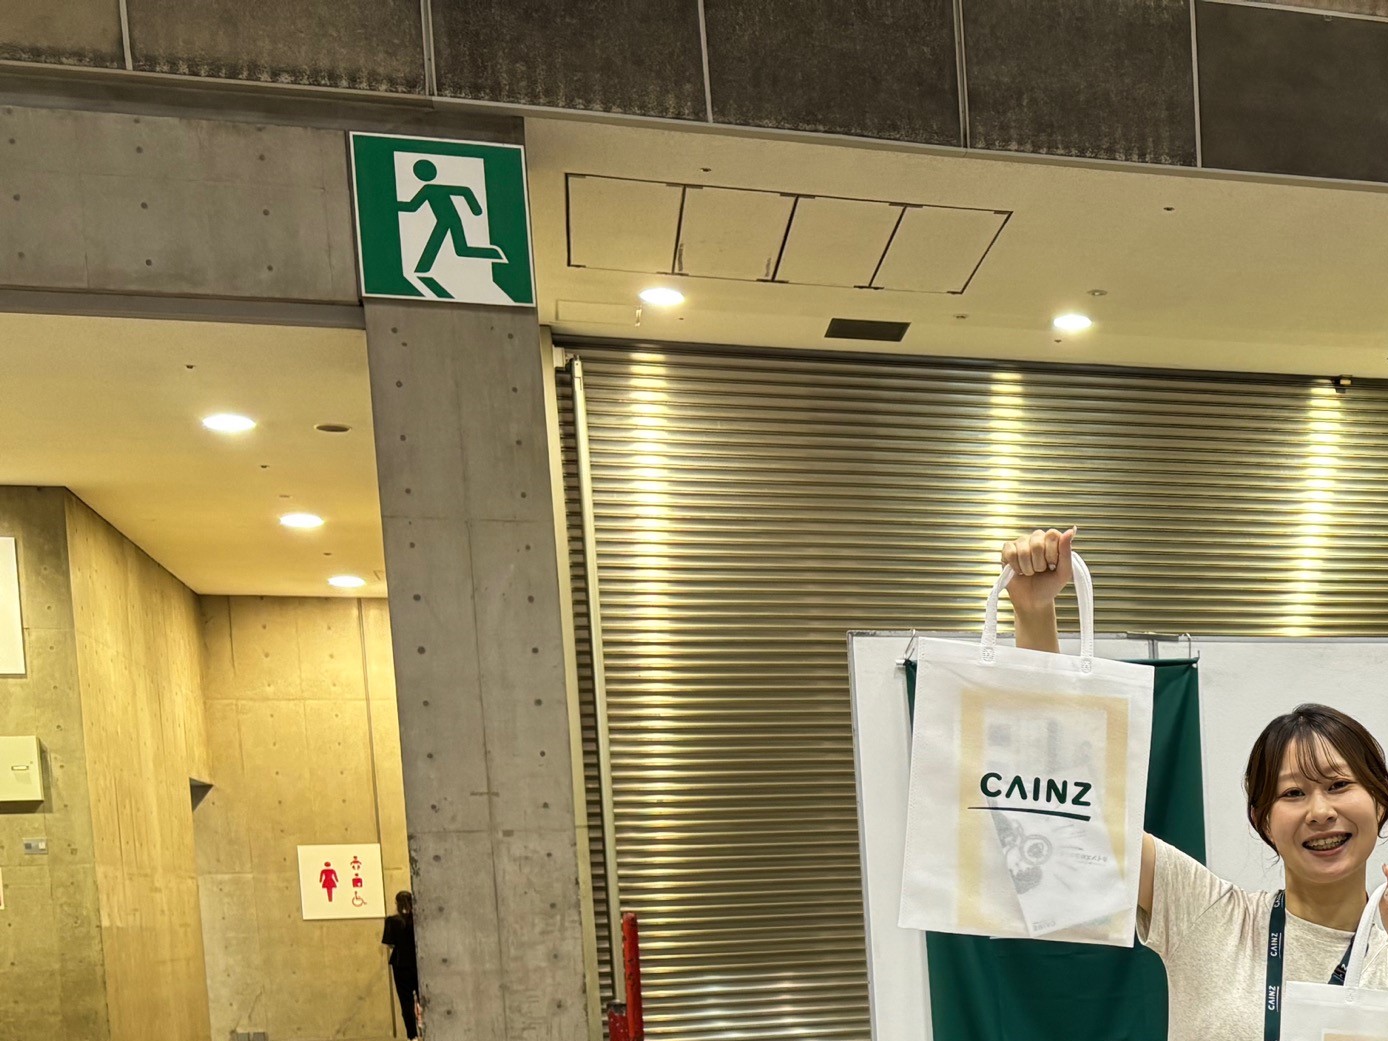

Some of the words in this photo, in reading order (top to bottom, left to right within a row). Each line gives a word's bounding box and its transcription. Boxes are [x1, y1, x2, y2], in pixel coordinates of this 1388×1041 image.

[980, 772, 1092, 807] CAINZ
[1270, 932, 1279, 957] CAINZ
[1267, 985, 1277, 1011] CAINZ
